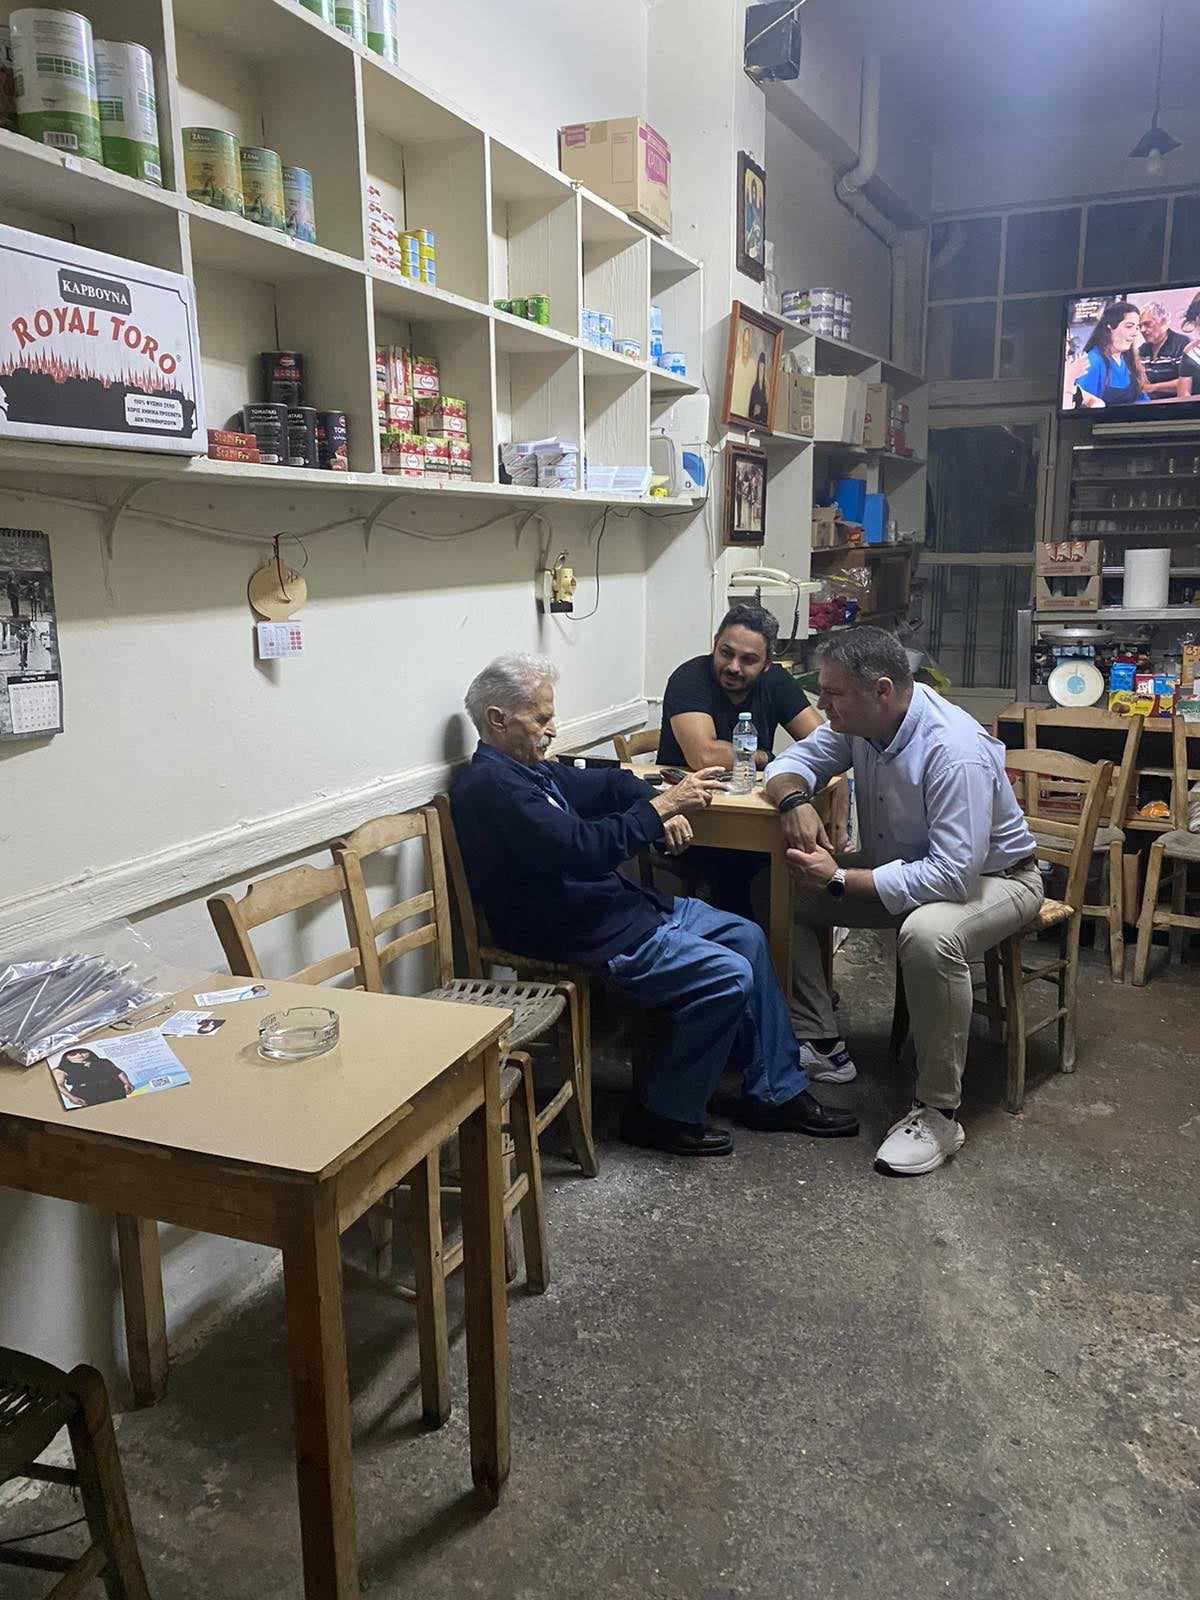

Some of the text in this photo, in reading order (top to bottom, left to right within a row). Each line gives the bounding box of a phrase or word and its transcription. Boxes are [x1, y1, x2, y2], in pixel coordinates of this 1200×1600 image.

[62, 279, 129, 306] ΚΑΡΒΟΥΝΑ
[12, 306, 177, 375] ROYAL TORO
